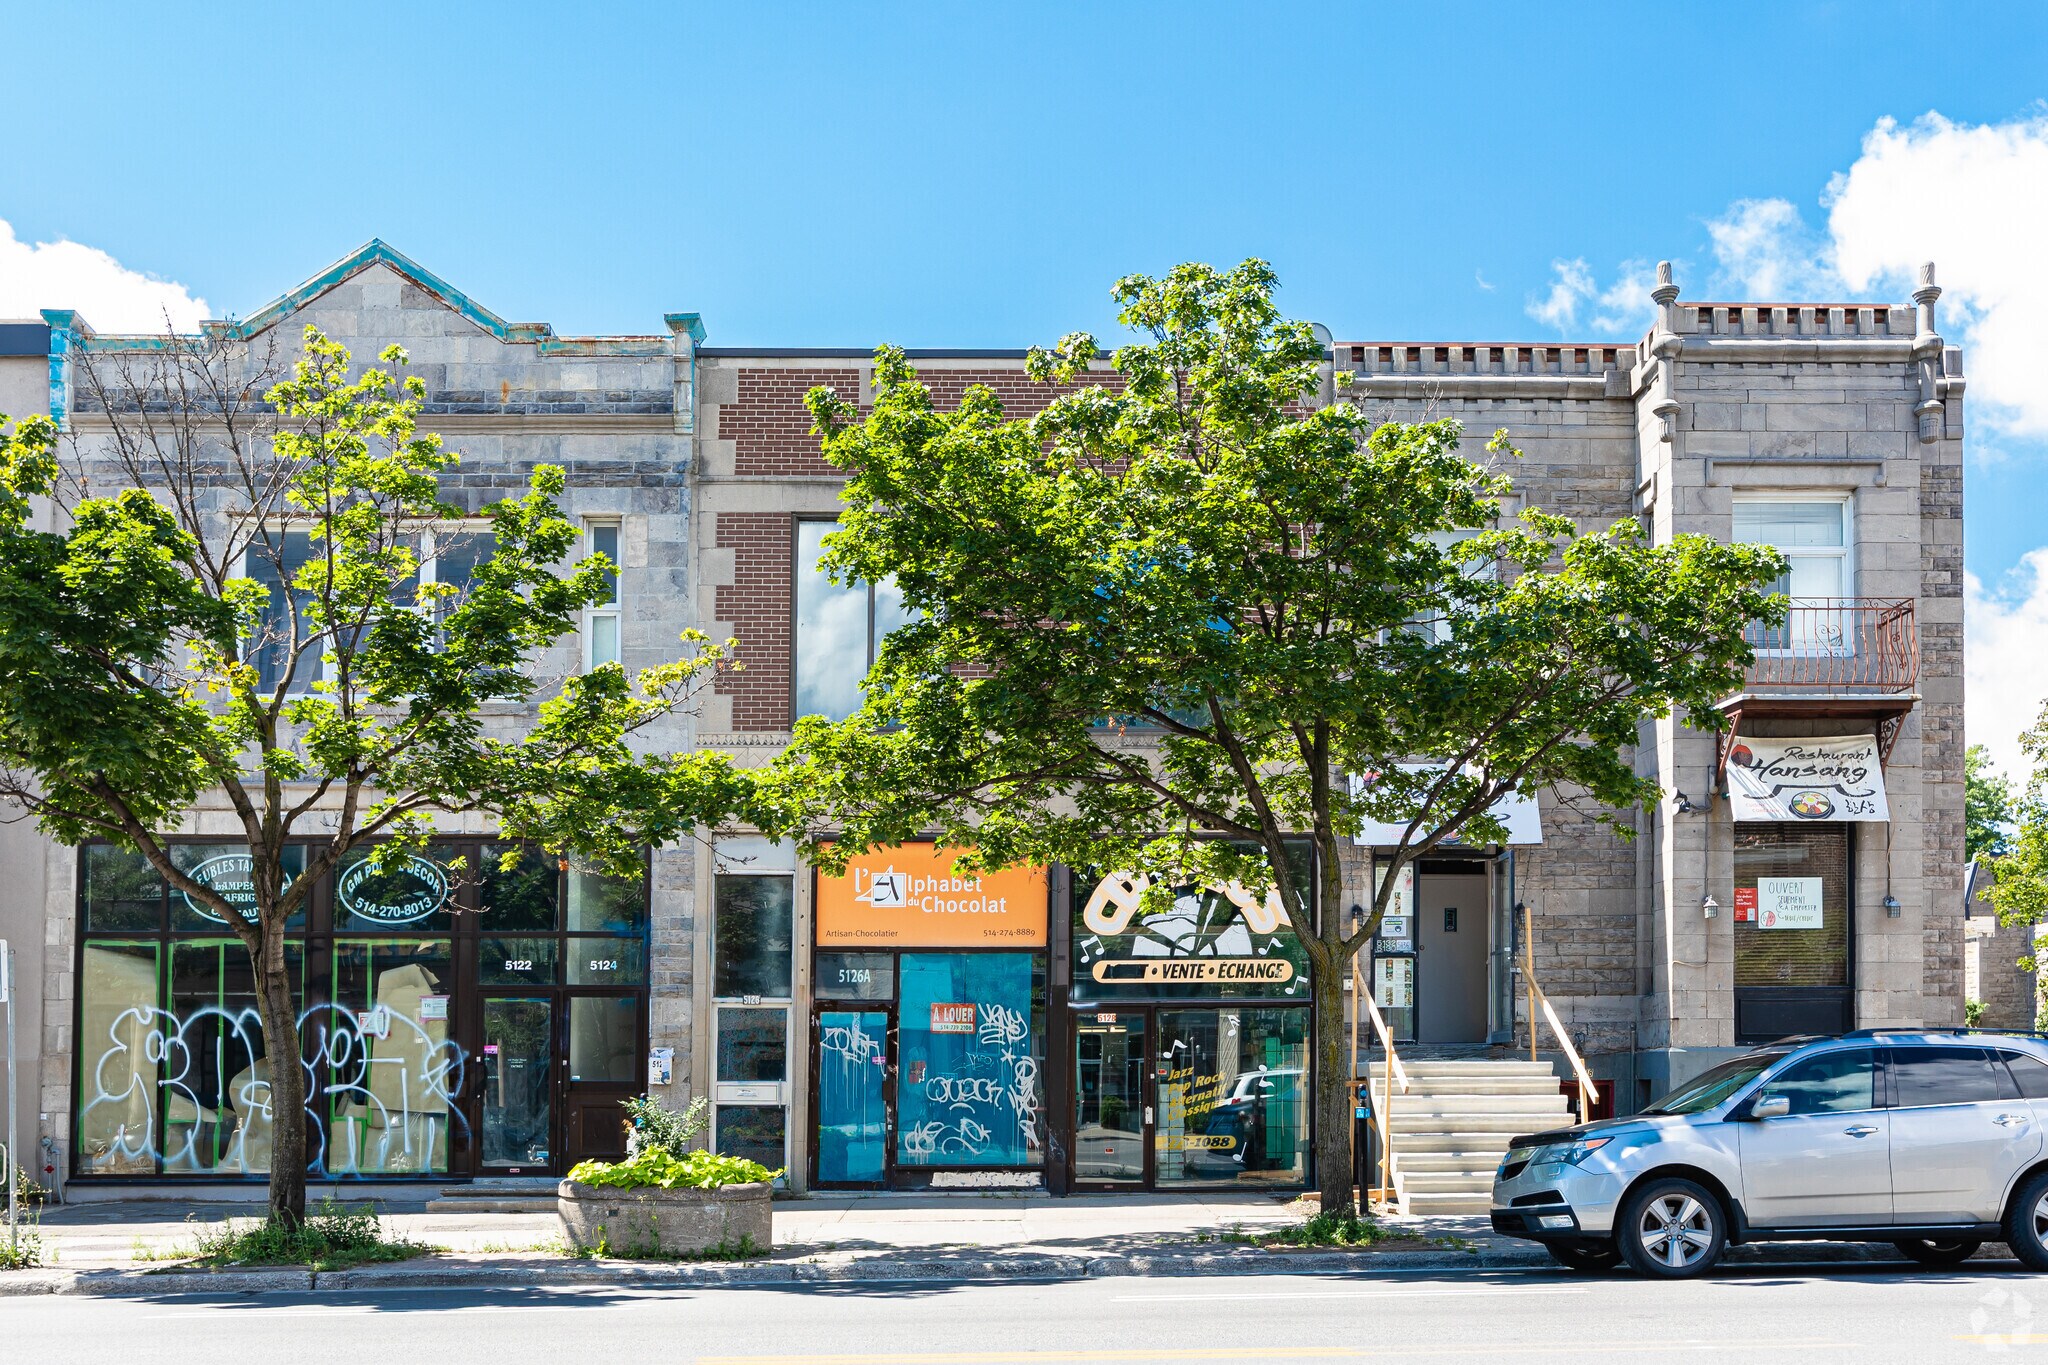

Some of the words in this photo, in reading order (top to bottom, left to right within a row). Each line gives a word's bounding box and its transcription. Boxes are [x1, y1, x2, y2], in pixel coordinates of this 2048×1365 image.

[1784, 746, 1872, 761] Restaurant
[1750, 757, 1868, 785] Hansang
[196, 859, 235, 885] EUBLES
[347, 870, 363, 893] GM
[1768, 881, 1804, 894] OUVERT
[355, 897, 432, 918] 514-270-8013
[907, 897, 920, 906] du
[921, 896, 1007, 913] Chocolat
[825, 929, 899, 937] Artisan-Chocolatier
[983, 928, 1036, 937] 514-274-8889
[505, 960, 532, 971] 5122
[590, 960, 618, 971] 5124
[1163, 963, 1205, 979] VENTE
[1218, 962, 1285, 979] ÉCHANGE
[838, 969, 871, 983] 5126A
[944, 1007, 974, 1022] LOUER
[1098, 1014, 1116, 1022] 5128
[1168, 1067, 1194, 1081] Jazz
[1168, 1082, 1191, 1094] Pop
[1195, 1071, 1227, 1087] Rock
[1168, 1083, 1227, 1109] Alternatif
[1168, 1099, 1226, 1120] Classique
